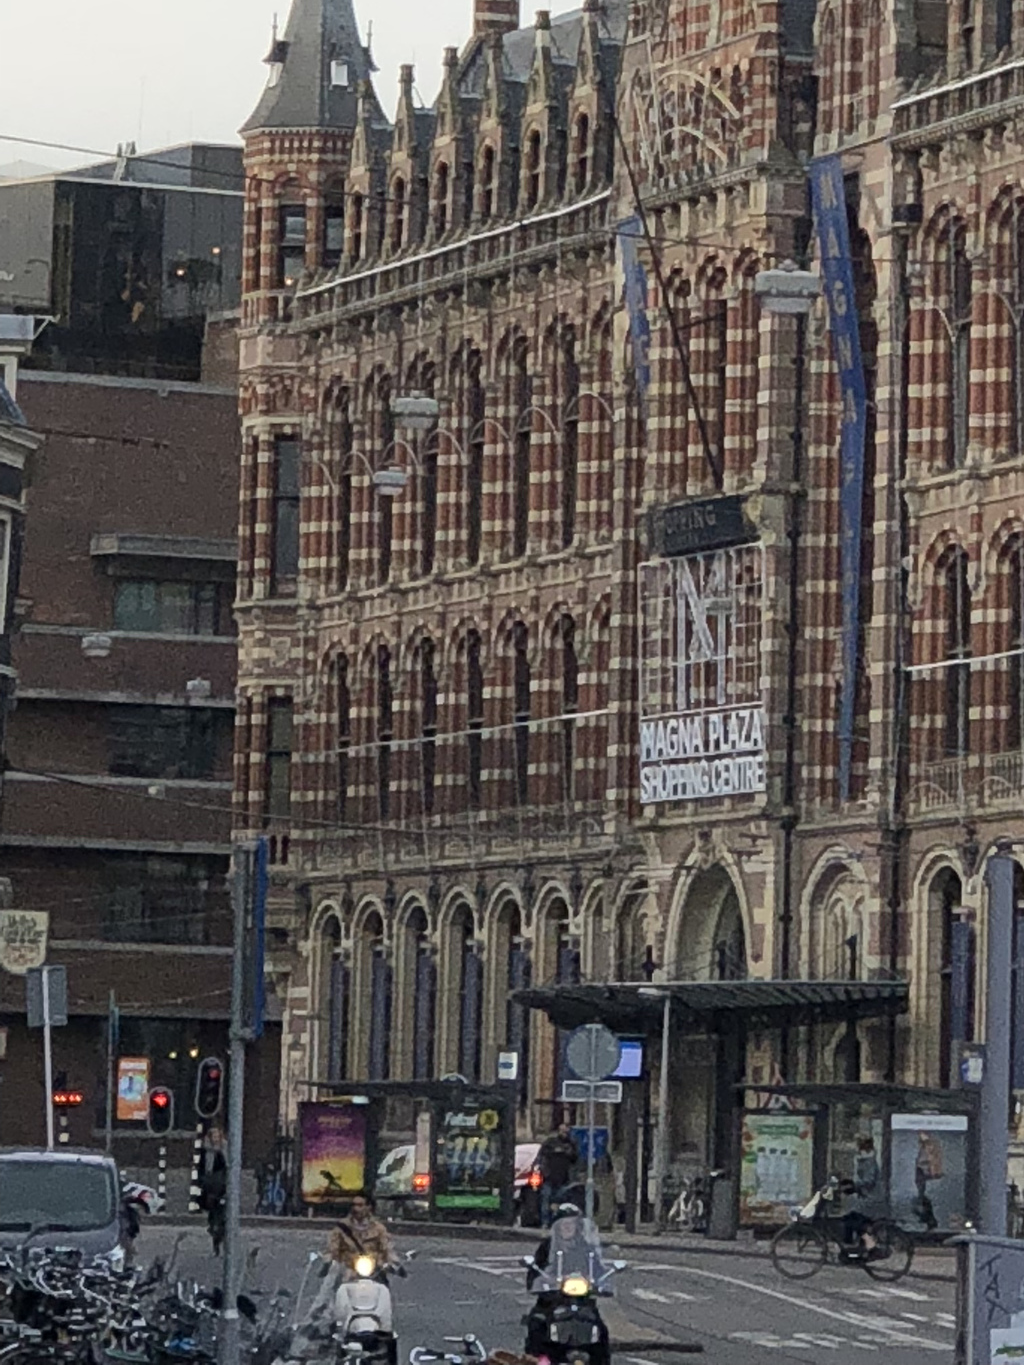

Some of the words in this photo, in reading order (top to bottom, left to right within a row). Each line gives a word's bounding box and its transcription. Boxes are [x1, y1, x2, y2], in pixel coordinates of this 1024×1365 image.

[819, 171, 858, 424] MAGNA
[640, 716, 704, 762] MAGNA
[708, 709, 763, 753] PLAZA
[640, 759, 710, 803] SHOPPING
[711, 755, 766, 793] CENTRE
